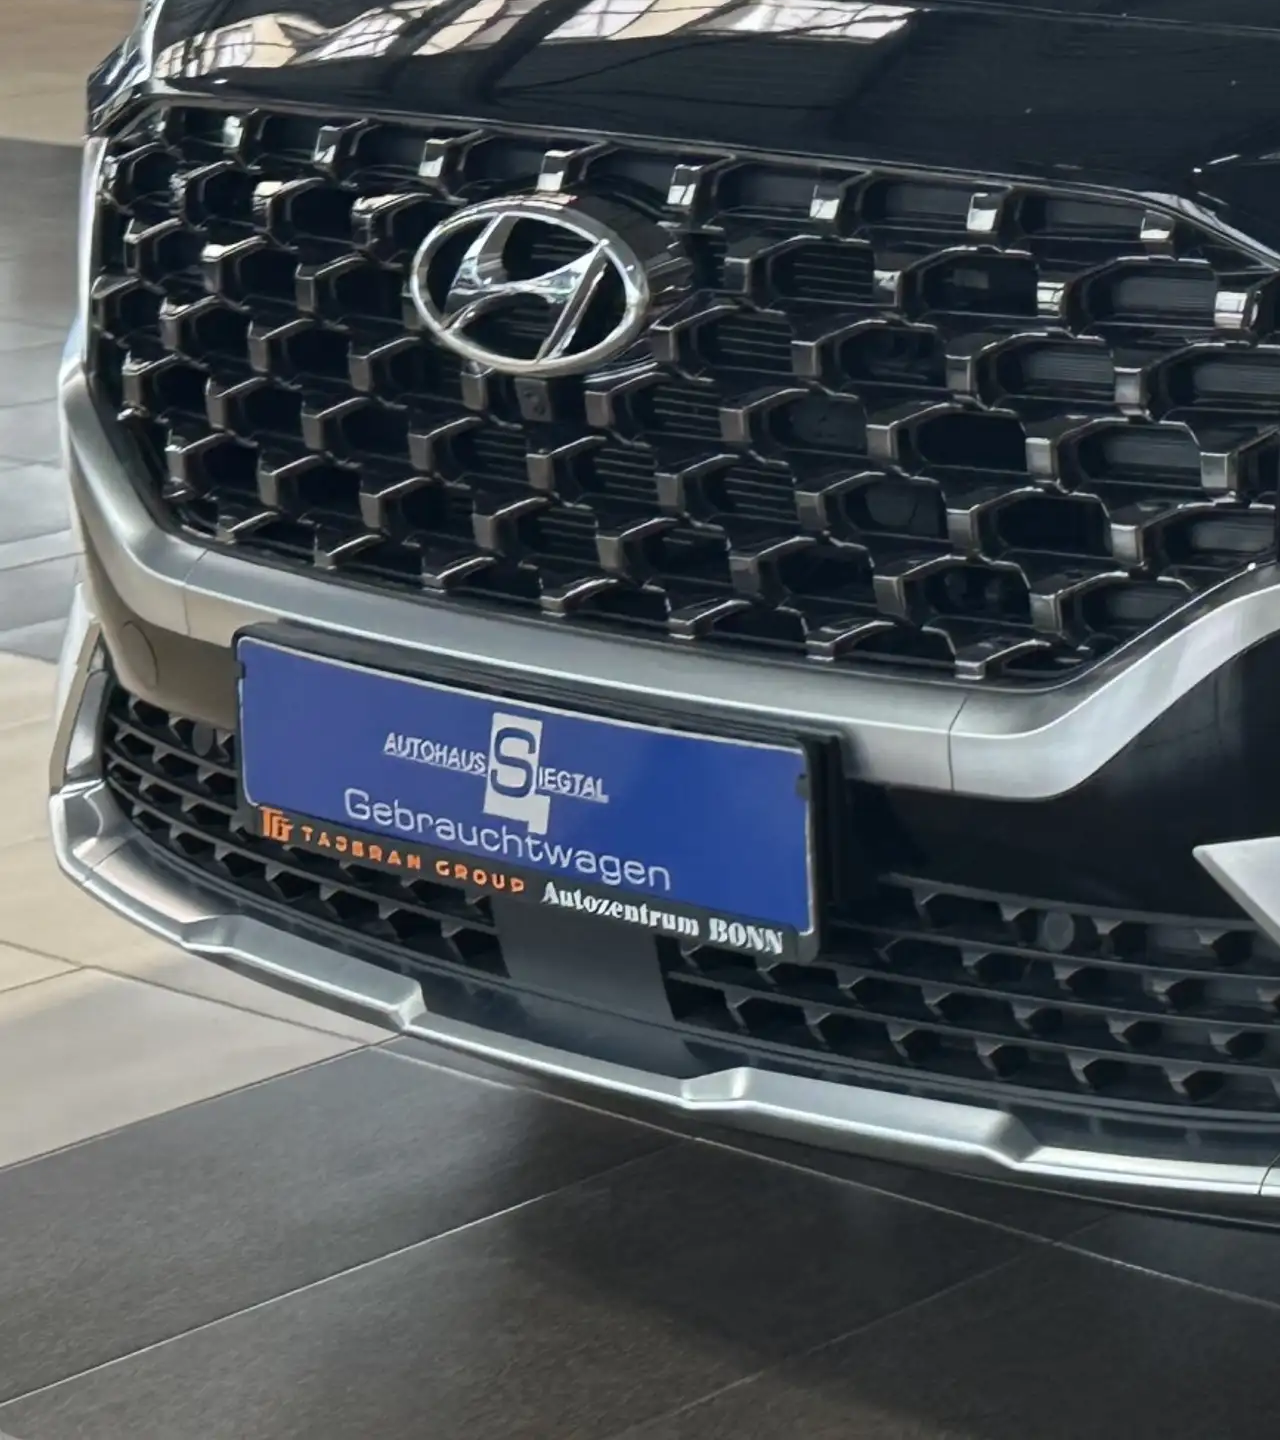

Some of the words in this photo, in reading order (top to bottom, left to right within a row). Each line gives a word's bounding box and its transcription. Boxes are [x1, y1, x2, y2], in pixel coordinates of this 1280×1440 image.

[383, 732, 488, 777] AUTOHAUS
[490, 726, 610, 804] SIEGTAL
[344, 787, 672, 892] Gebrauchtwagen
[435, 859, 526, 894] GROUP
[540, 881, 701, 937] Autozentrum
[708, 917, 784, 955] BONN
